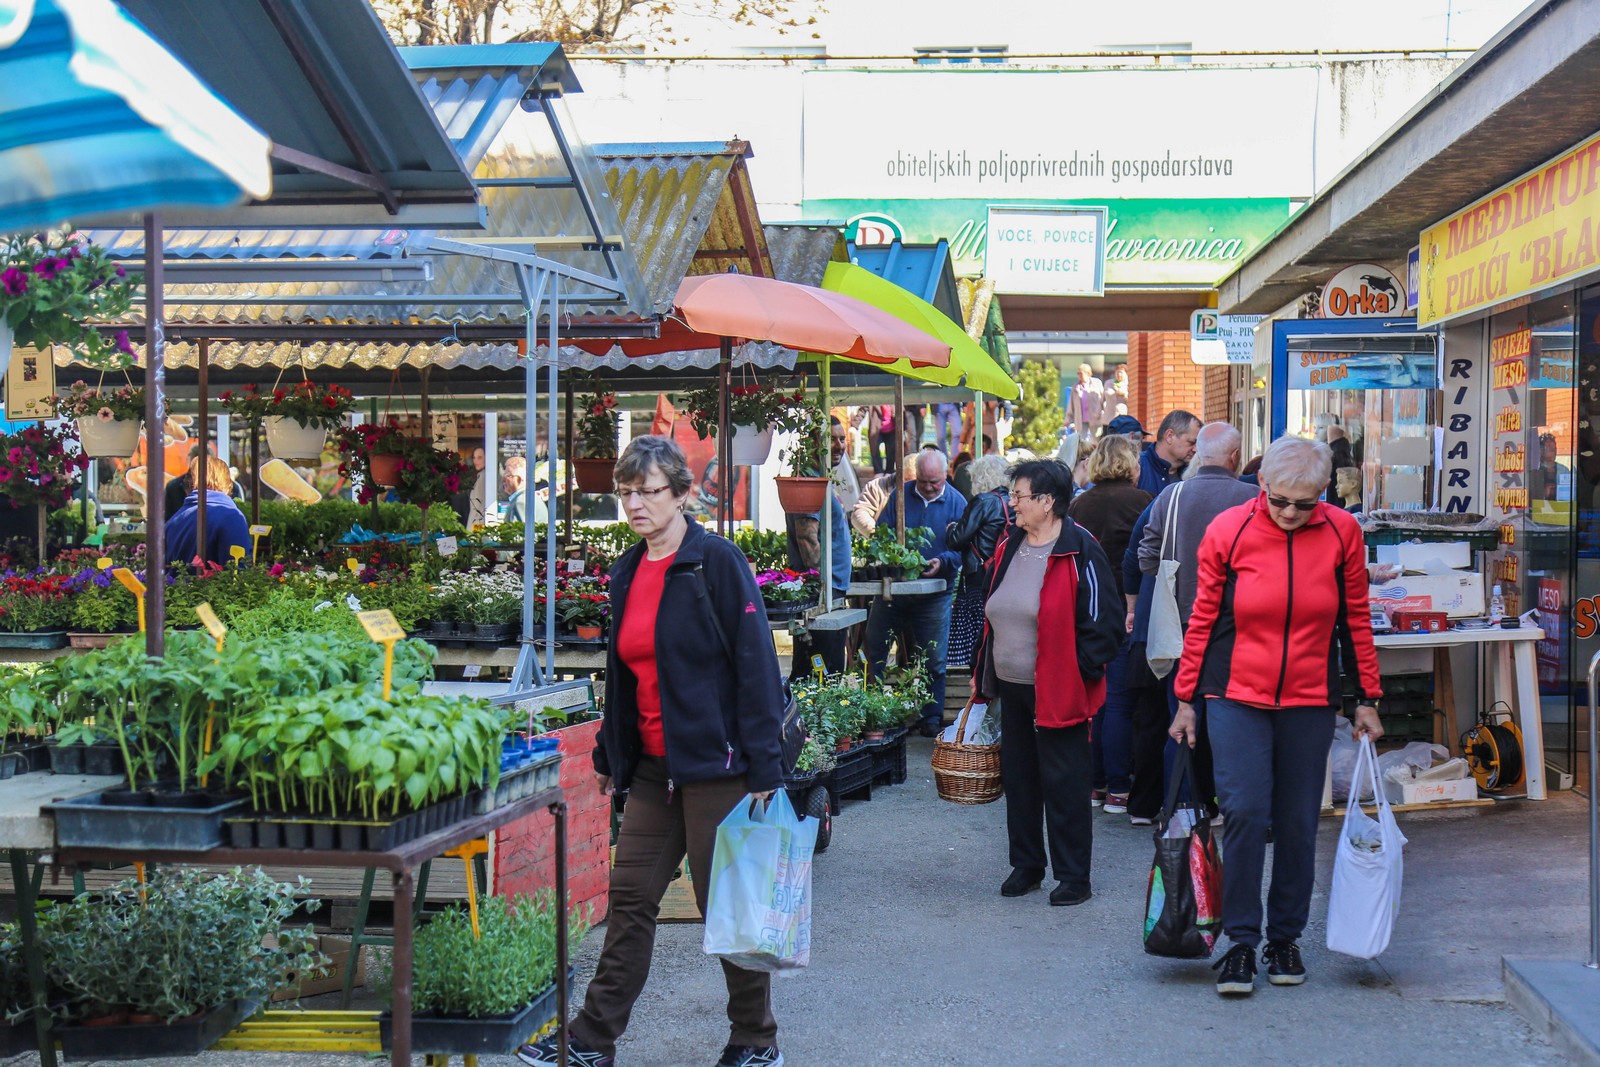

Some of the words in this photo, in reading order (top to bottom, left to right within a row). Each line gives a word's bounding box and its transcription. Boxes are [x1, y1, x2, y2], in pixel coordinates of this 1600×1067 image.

[887, 149, 971, 184] obiteljskih
[978, 149, 1105, 184] poljoprivrednih
[1111, 149, 1234, 184] gospodarstava
[1043, 228, 1094, 244] POVRCE
[1009, 257, 1014, 272] I
[1022, 257, 1079, 273] CVIJECE
[1444, 240, 1511, 315] PILIĆI
[1328, 284, 1391, 317] Orka
[1225, 339, 1254, 348] ČAKOV
[1309, 363, 1348, 387] RIBA
